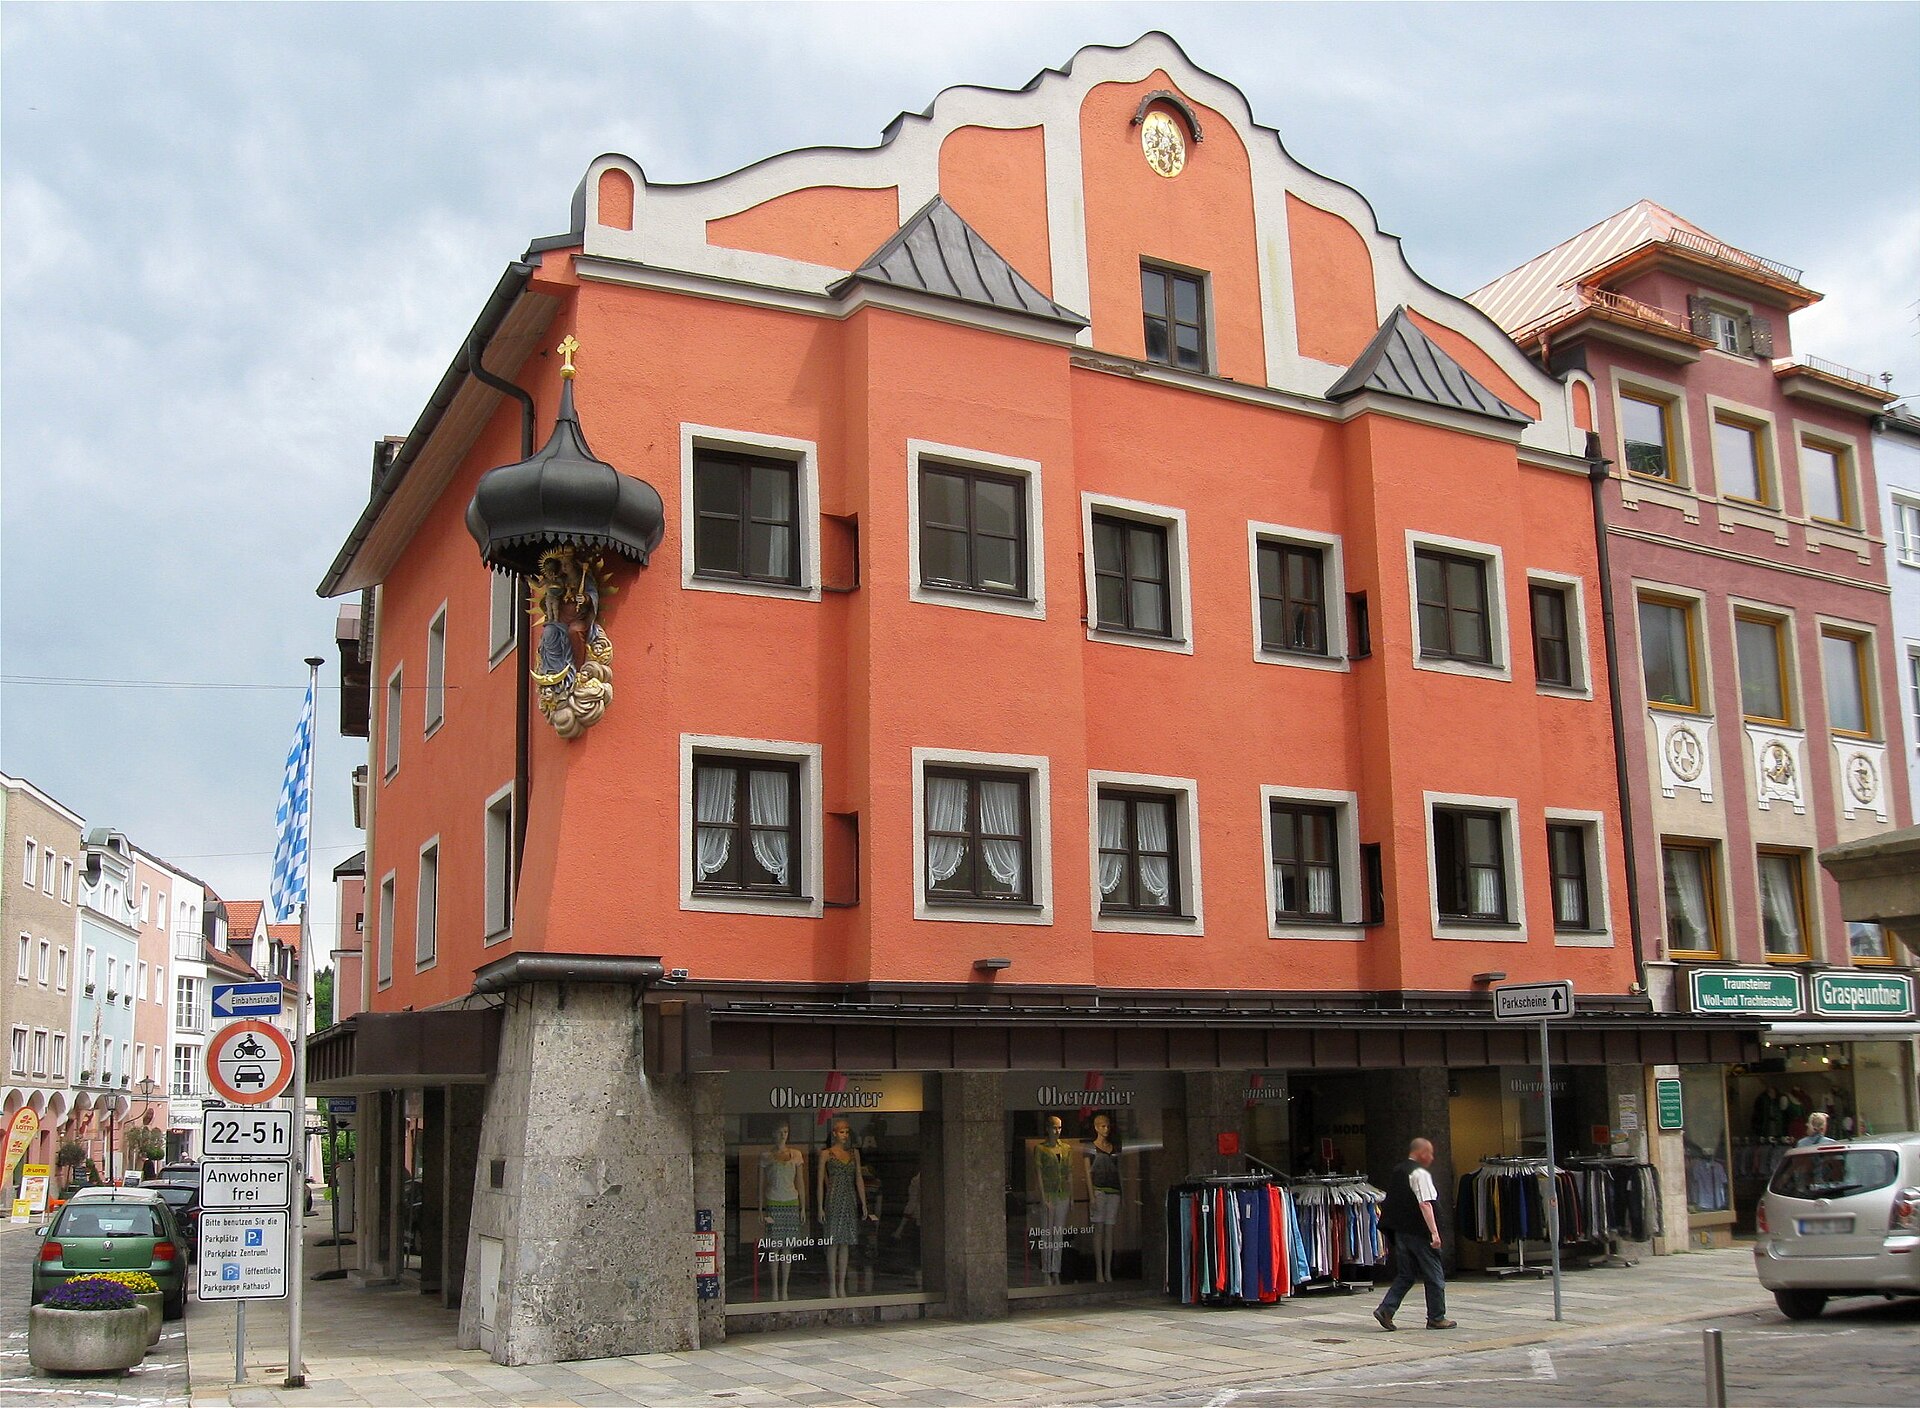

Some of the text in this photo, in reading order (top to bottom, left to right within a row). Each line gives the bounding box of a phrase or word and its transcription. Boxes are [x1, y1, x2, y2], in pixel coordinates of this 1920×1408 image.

[1722, 977, 1772, 990] Traunsteiner
[231, 996, 277, 1005] Einbahnstraße
[1740, 995, 1793, 1007] Trachtenstube
[1821, 980, 1901, 1010] Graspeuntner
[1502, 995, 1547, 1009] Parkscheine
[770, 1085, 883, 1108] Obermaier
[1037, 1085, 1136, 1106] Obermaier
[211, 1121, 283, 1144] 22-5 h
[206, 1169, 284, 1182] Anwohner
[233, 1187, 258, 1200] frei
[205, 1217, 278, 1226] Bitte benutzen Sie die
[1029, 1224, 1095, 1237] Alles Mode auf
[205, 1235, 239, 1244] Parkplätze
[758, 1235, 833, 1248] Alles Mode auf
[1029, 1240, 1035, 1250] 7
[205, 1249, 237, 1259] (Parkplatz
[758, 1252, 807, 1264] 7 Etagen.
[245, 1267, 281, 1275] (öffentliche
[204, 1281, 271, 1293] Parkgarage Rathaus)
